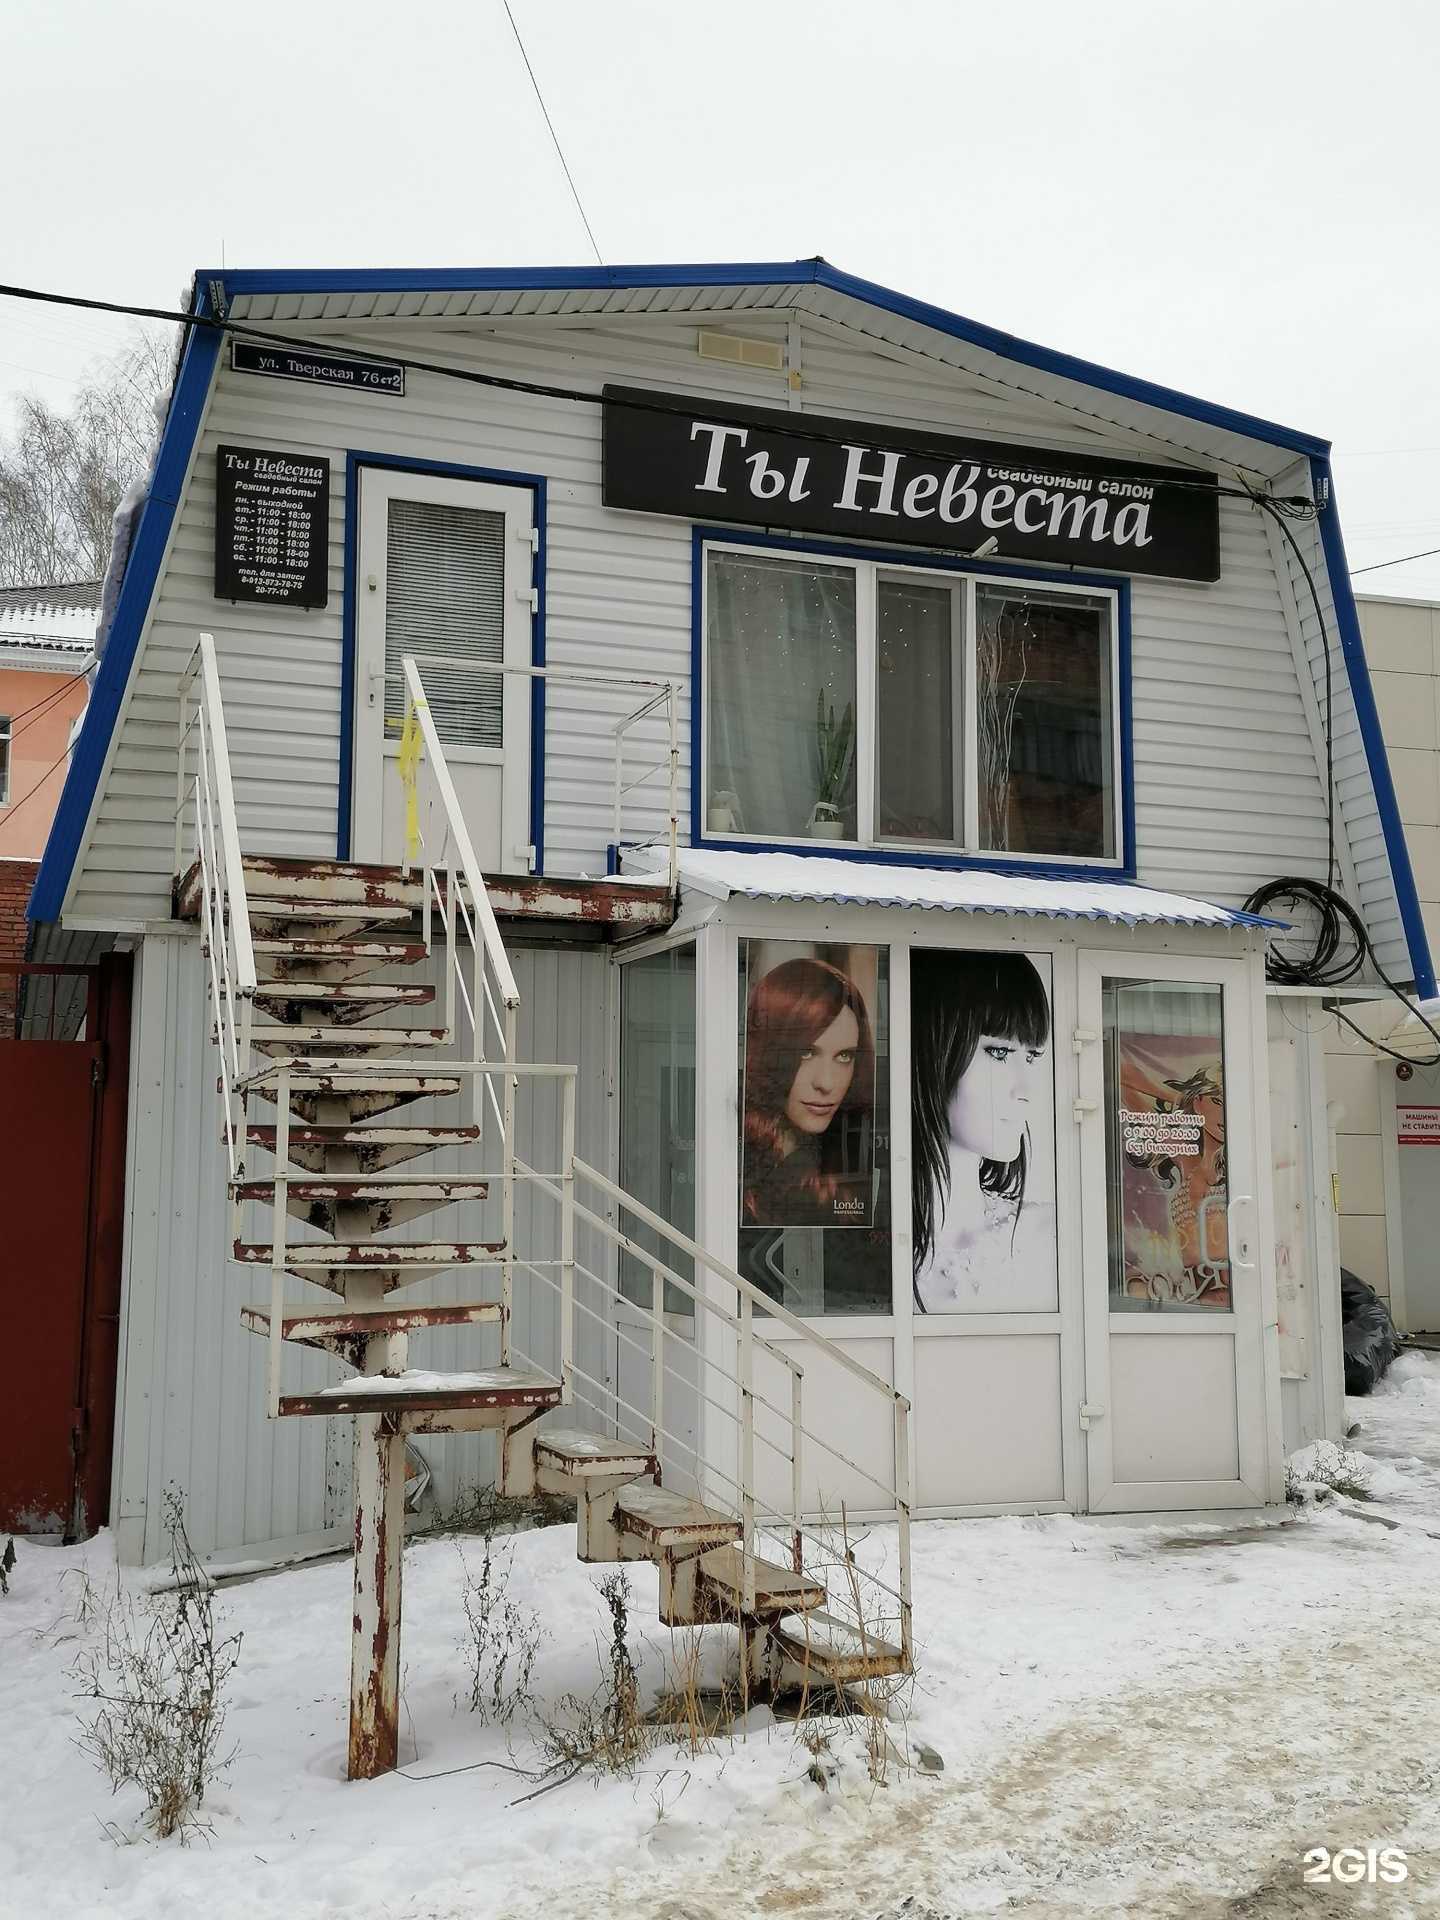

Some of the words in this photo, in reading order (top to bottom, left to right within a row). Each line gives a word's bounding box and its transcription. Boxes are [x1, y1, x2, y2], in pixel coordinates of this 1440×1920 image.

[259, 357, 279, 368] ул.
[288, 360, 354, 380] Тверская
[225, 454, 249, 470] Ты
[254, 458, 323, 478] Невеста
[254, 472, 297, 482] свадебный
[235, 481, 269, 492] Режим
[272, 486, 316, 498] работы
[690, 422, 811, 503] Ты
[833, 444, 1154, 548] Невеста
[1098, 480, 1154, 499] салон
[257, 499, 303, 510] выходной
[257, 508, 280, 516] 11:00
[288, 512, 311, 520] 18:00
[235, 516, 248, 524] ср.
[257, 517, 280, 526] 11:00
[288, 521, 310, 529] 18:00
[256, 527, 278, 535] 11:00
[287, 530, 309, 539] 18:00
[256, 536, 278, 545] 11:00
[286, 540, 309, 548] 18:00
[255, 546, 278, 554] 11:00
[255, 555, 277, 564] 11:00
[286, 559, 308, 568] 18:00
[260, 568, 275, 577] для
[276, 573, 305, 581] записи
[834, 1197, 864, 1209] Londa
